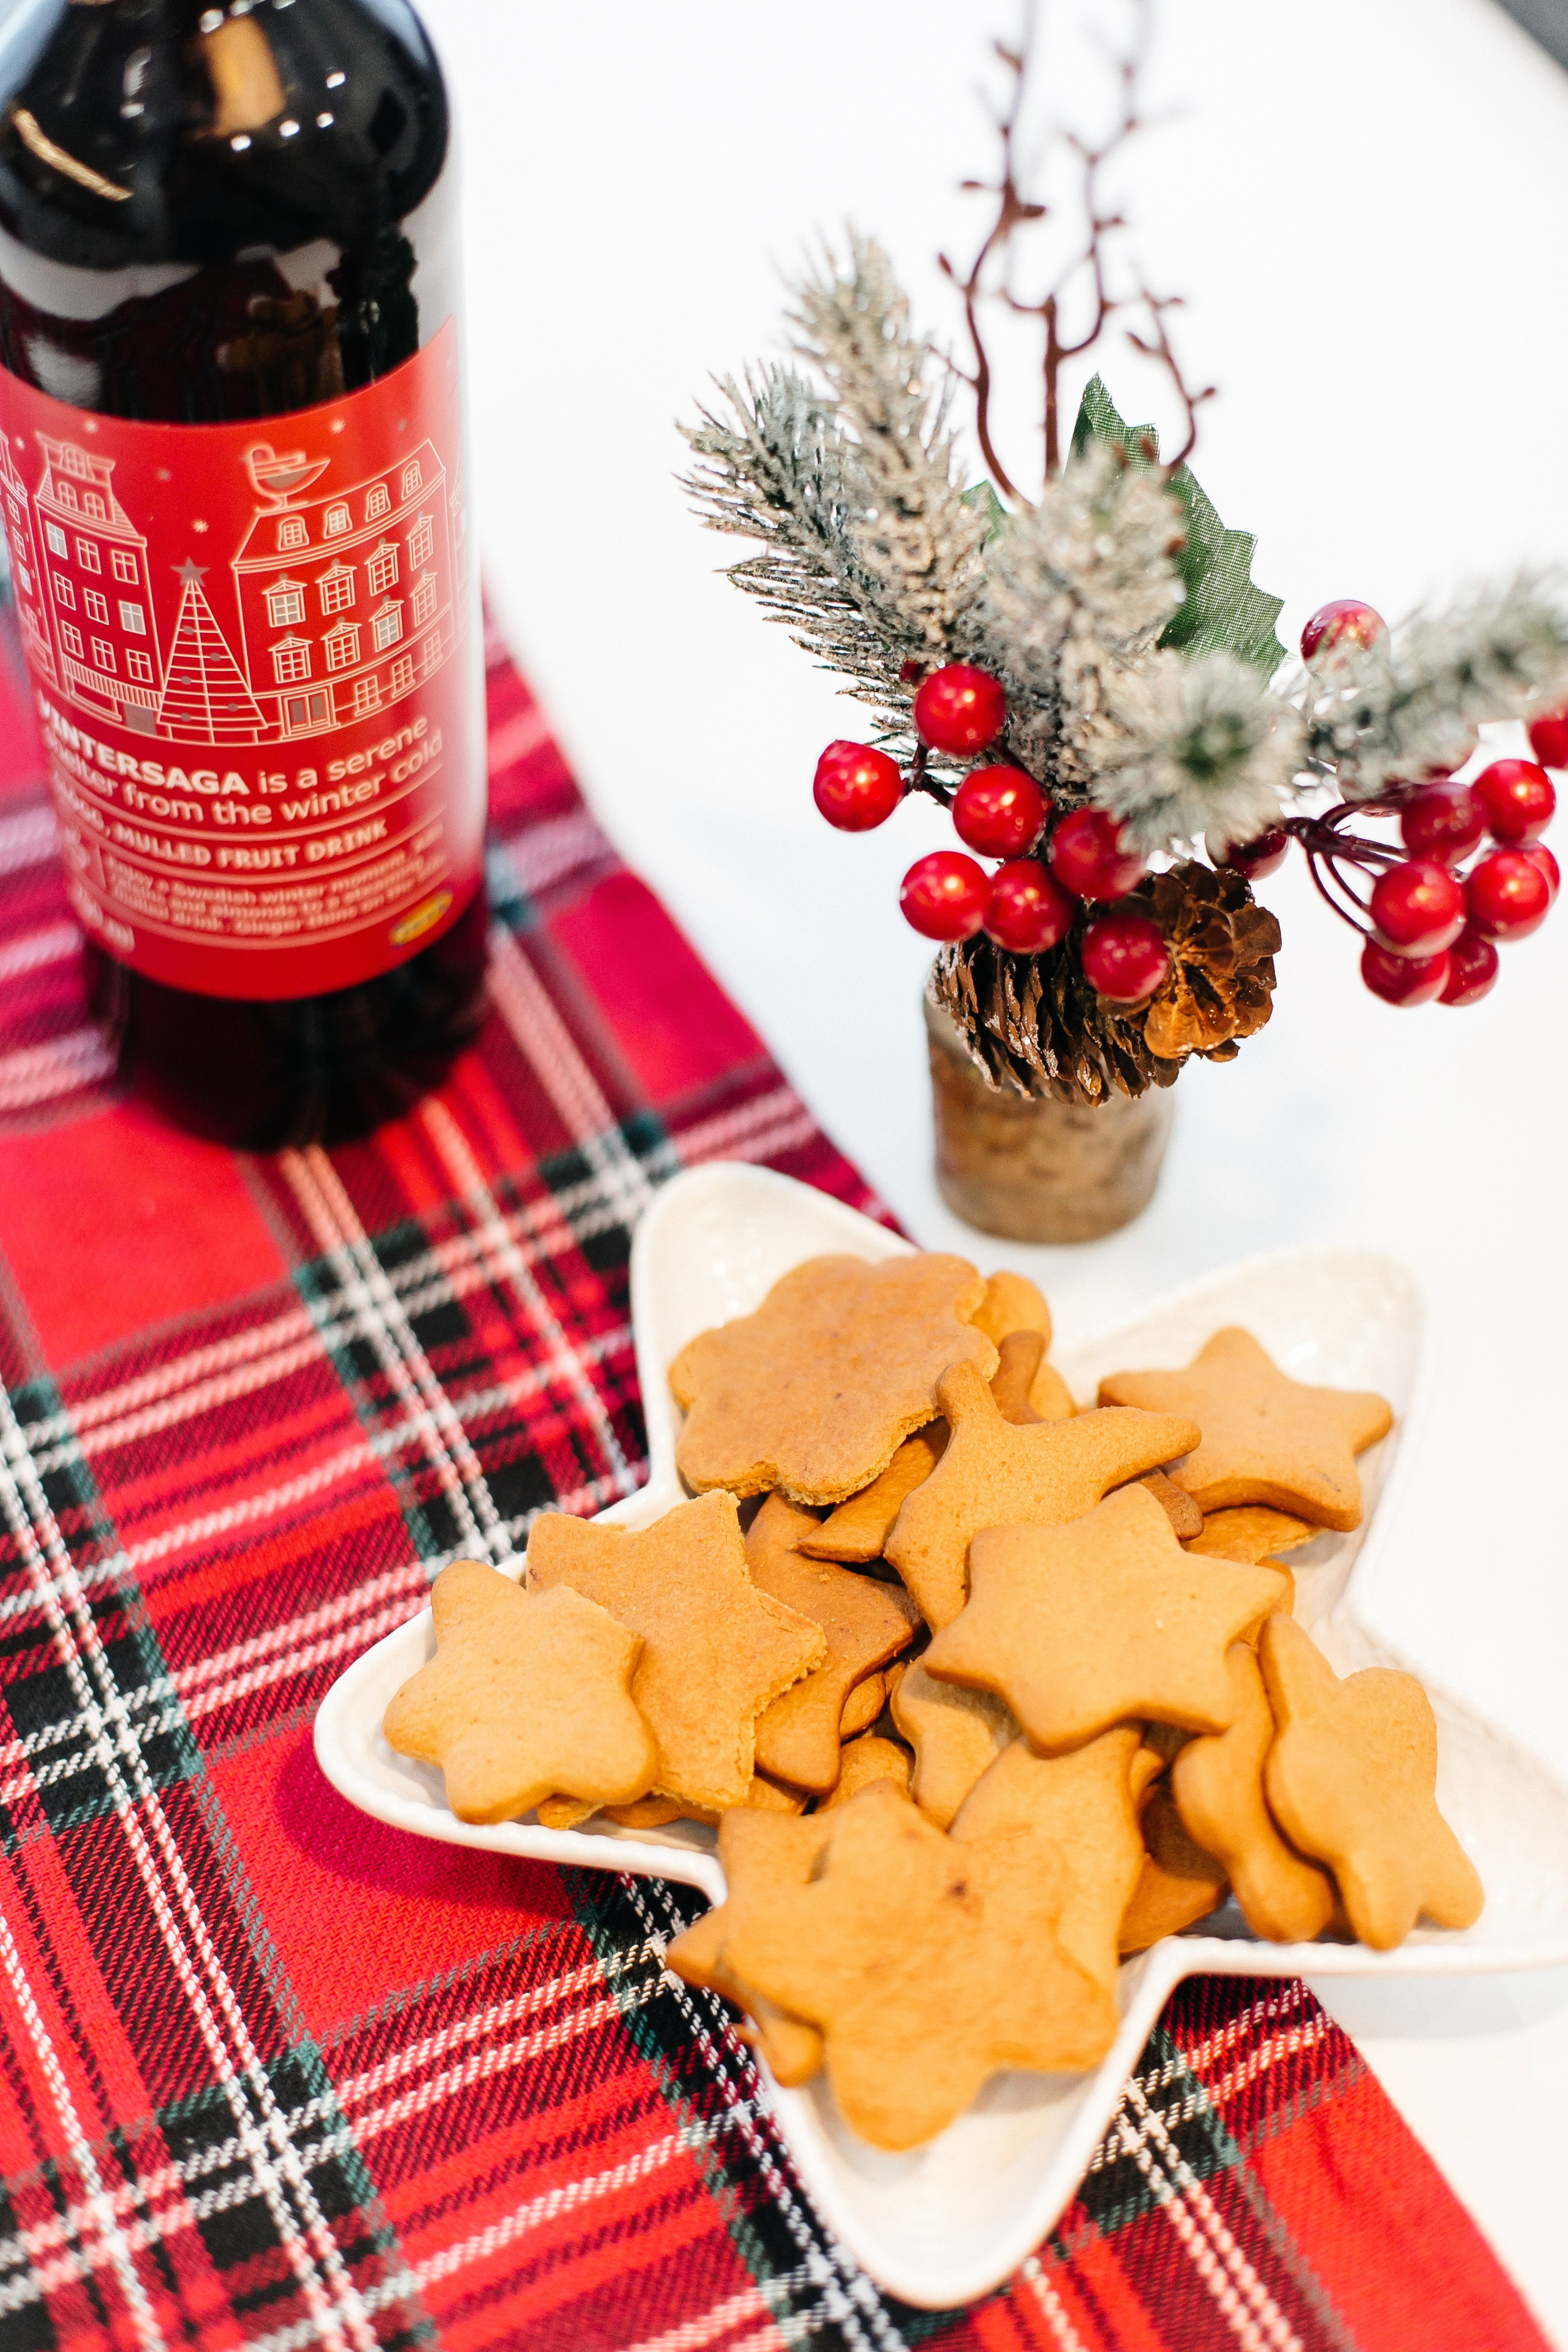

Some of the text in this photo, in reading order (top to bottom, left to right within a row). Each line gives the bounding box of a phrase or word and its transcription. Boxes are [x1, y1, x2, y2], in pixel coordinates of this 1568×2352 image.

[37, 690, 429, 796] VINTERSAGA is a serene
[124, 781, 204, 823] from
[212, 799, 273, 826] the
[280, 772, 386, 821] winter
[388, 729, 442, 784] cold
[113, 821, 212, 866] MULLED
[216, 843, 300, 870] FRUIT
[304, 818, 388, 862] DRINK
[170, 881, 256, 903] Swedish
